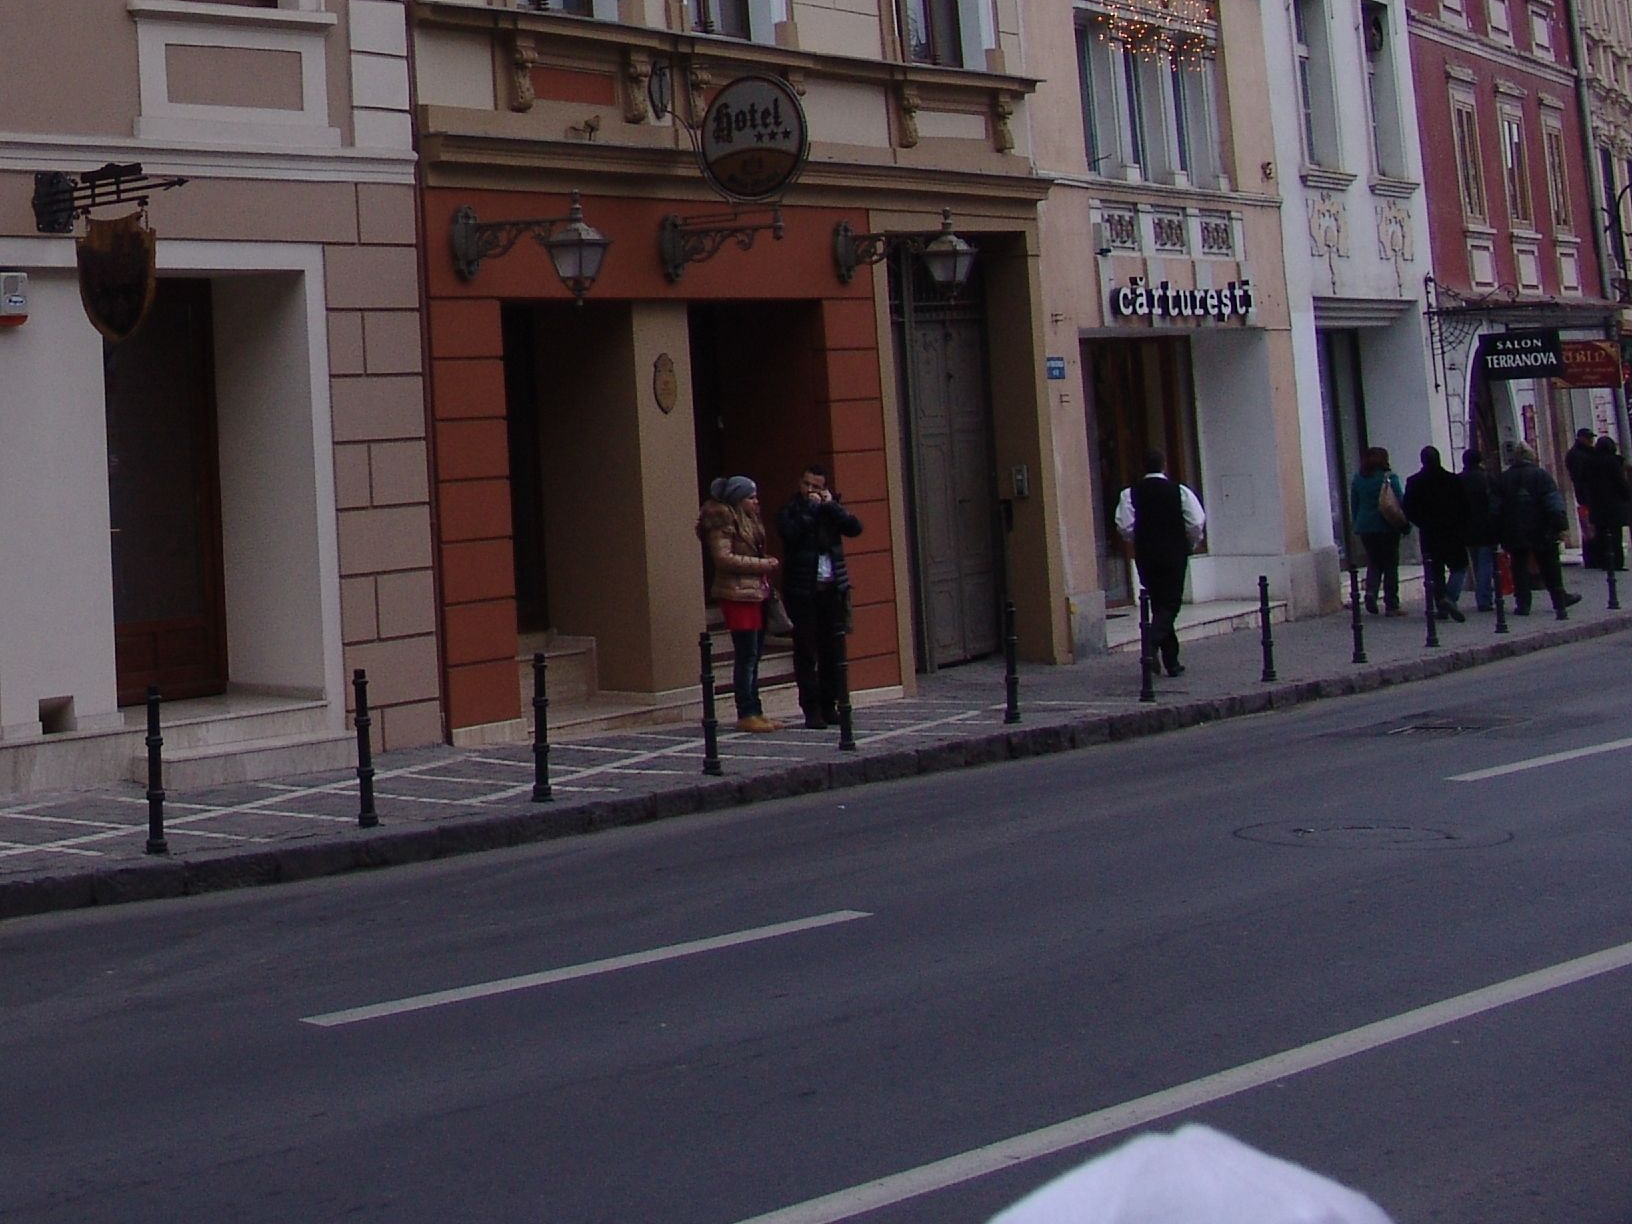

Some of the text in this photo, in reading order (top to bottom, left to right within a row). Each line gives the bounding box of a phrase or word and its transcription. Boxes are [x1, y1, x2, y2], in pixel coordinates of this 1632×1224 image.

[713, 97, 783, 144] Hotel
[1496, 338, 1542, 350] SALON
[1486, 352, 1558, 369] TERRANOVA
